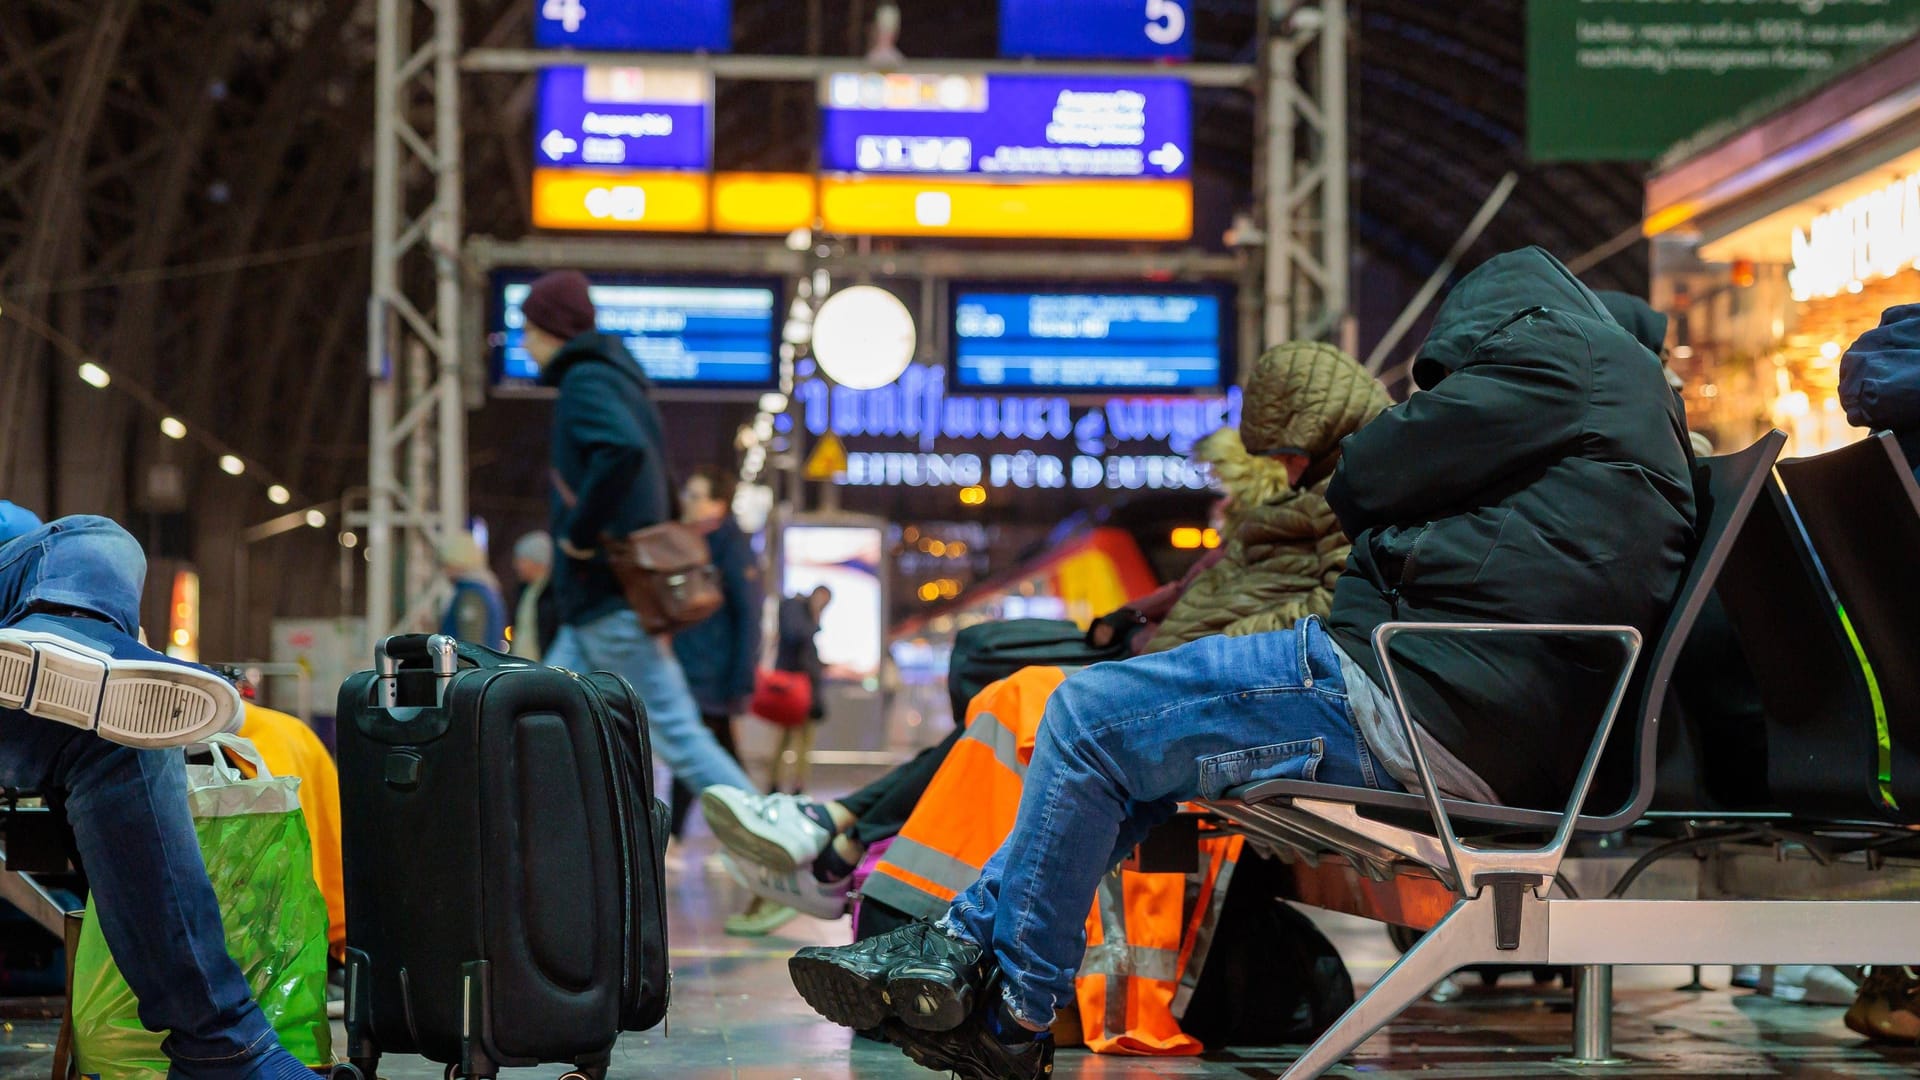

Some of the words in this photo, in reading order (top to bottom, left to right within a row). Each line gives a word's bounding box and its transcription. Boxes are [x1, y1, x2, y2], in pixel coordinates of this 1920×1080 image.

[542, 0, 586, 32] 4
[1144, 0, 1185, 44] 5
[990, 449, 1067, 489] FÜR
